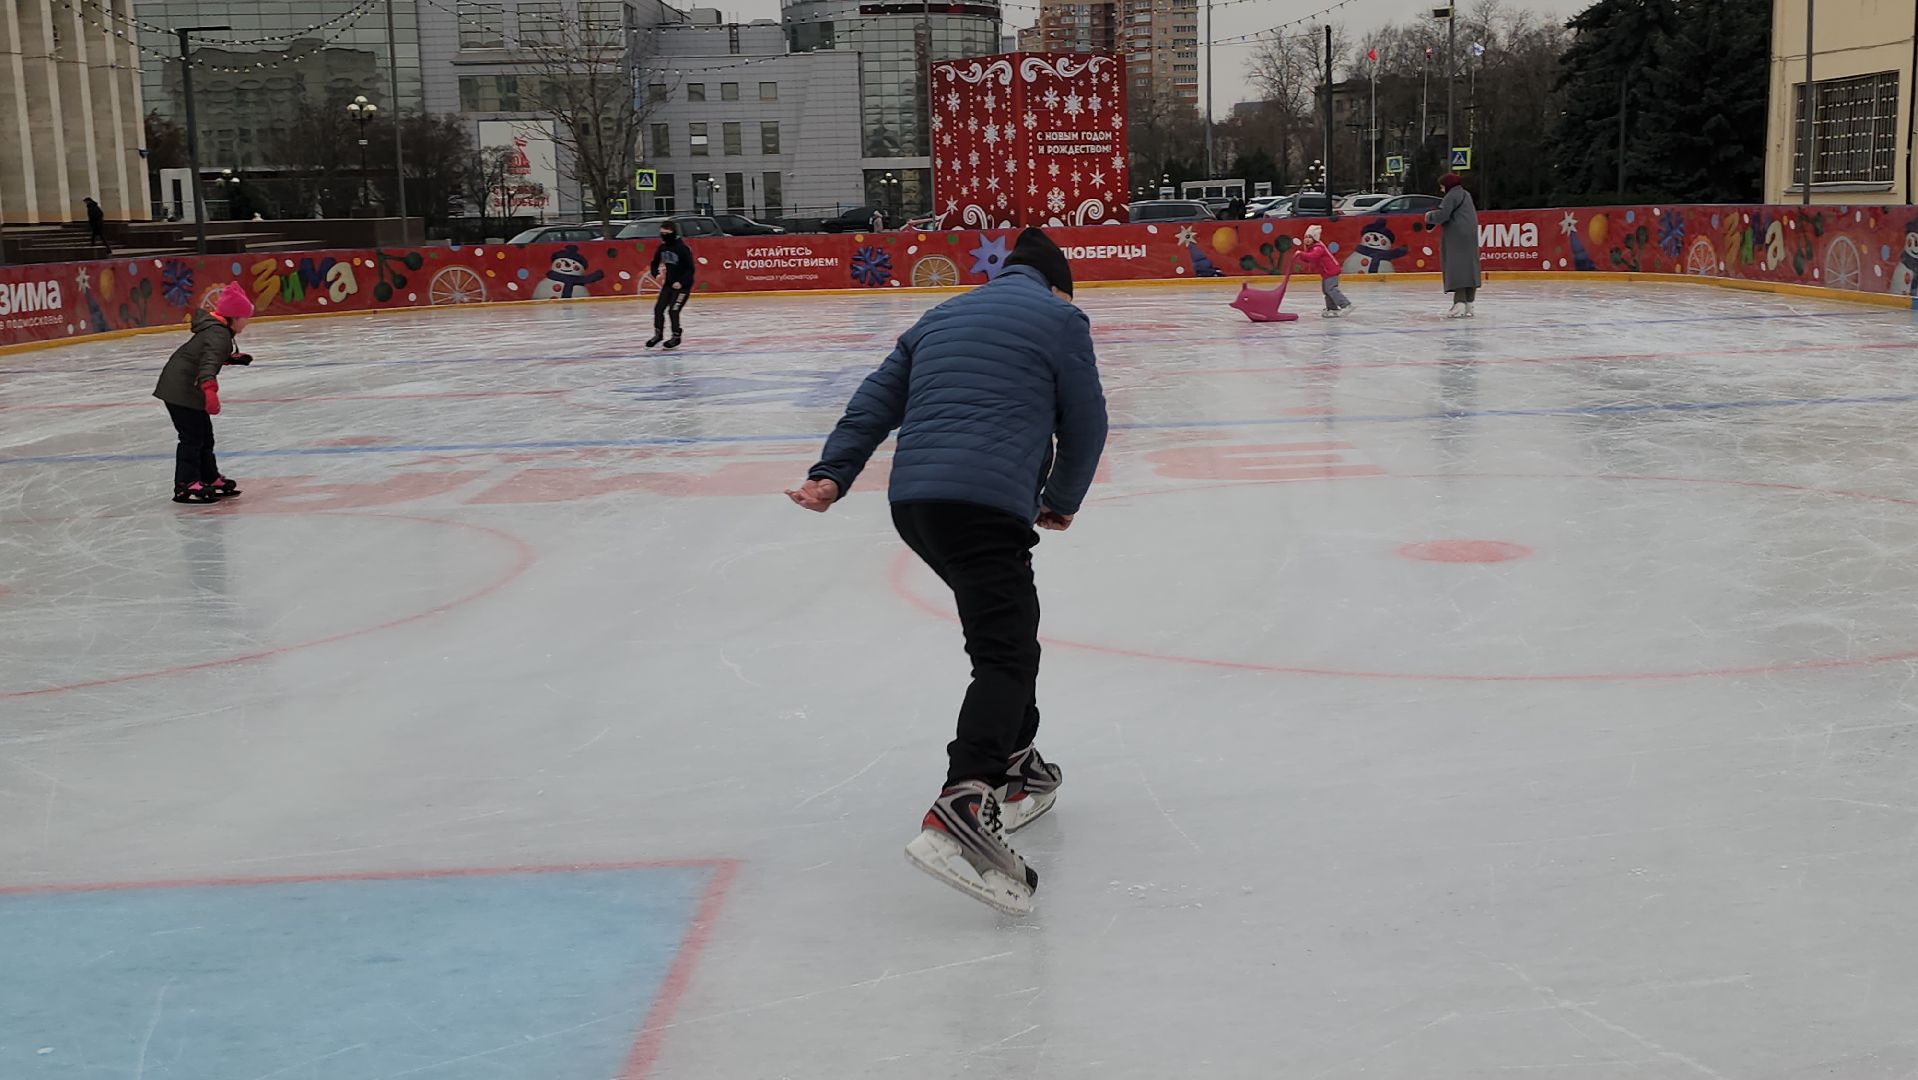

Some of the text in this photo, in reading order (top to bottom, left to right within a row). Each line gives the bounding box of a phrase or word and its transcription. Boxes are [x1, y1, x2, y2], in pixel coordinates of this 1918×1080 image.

[1036, 131, 1112, 142] С НОВЫМ ГОДОМ
[1038, 144, 1112, 155] И РОЖДЕСТВОМ!
[1477, 222, 1539, 248] има
[746, 245, 813, 257] КАТАЙТЕСЬ
[723, 257, 839, 270] С УДОВОЛЬСТВИЕМ!
